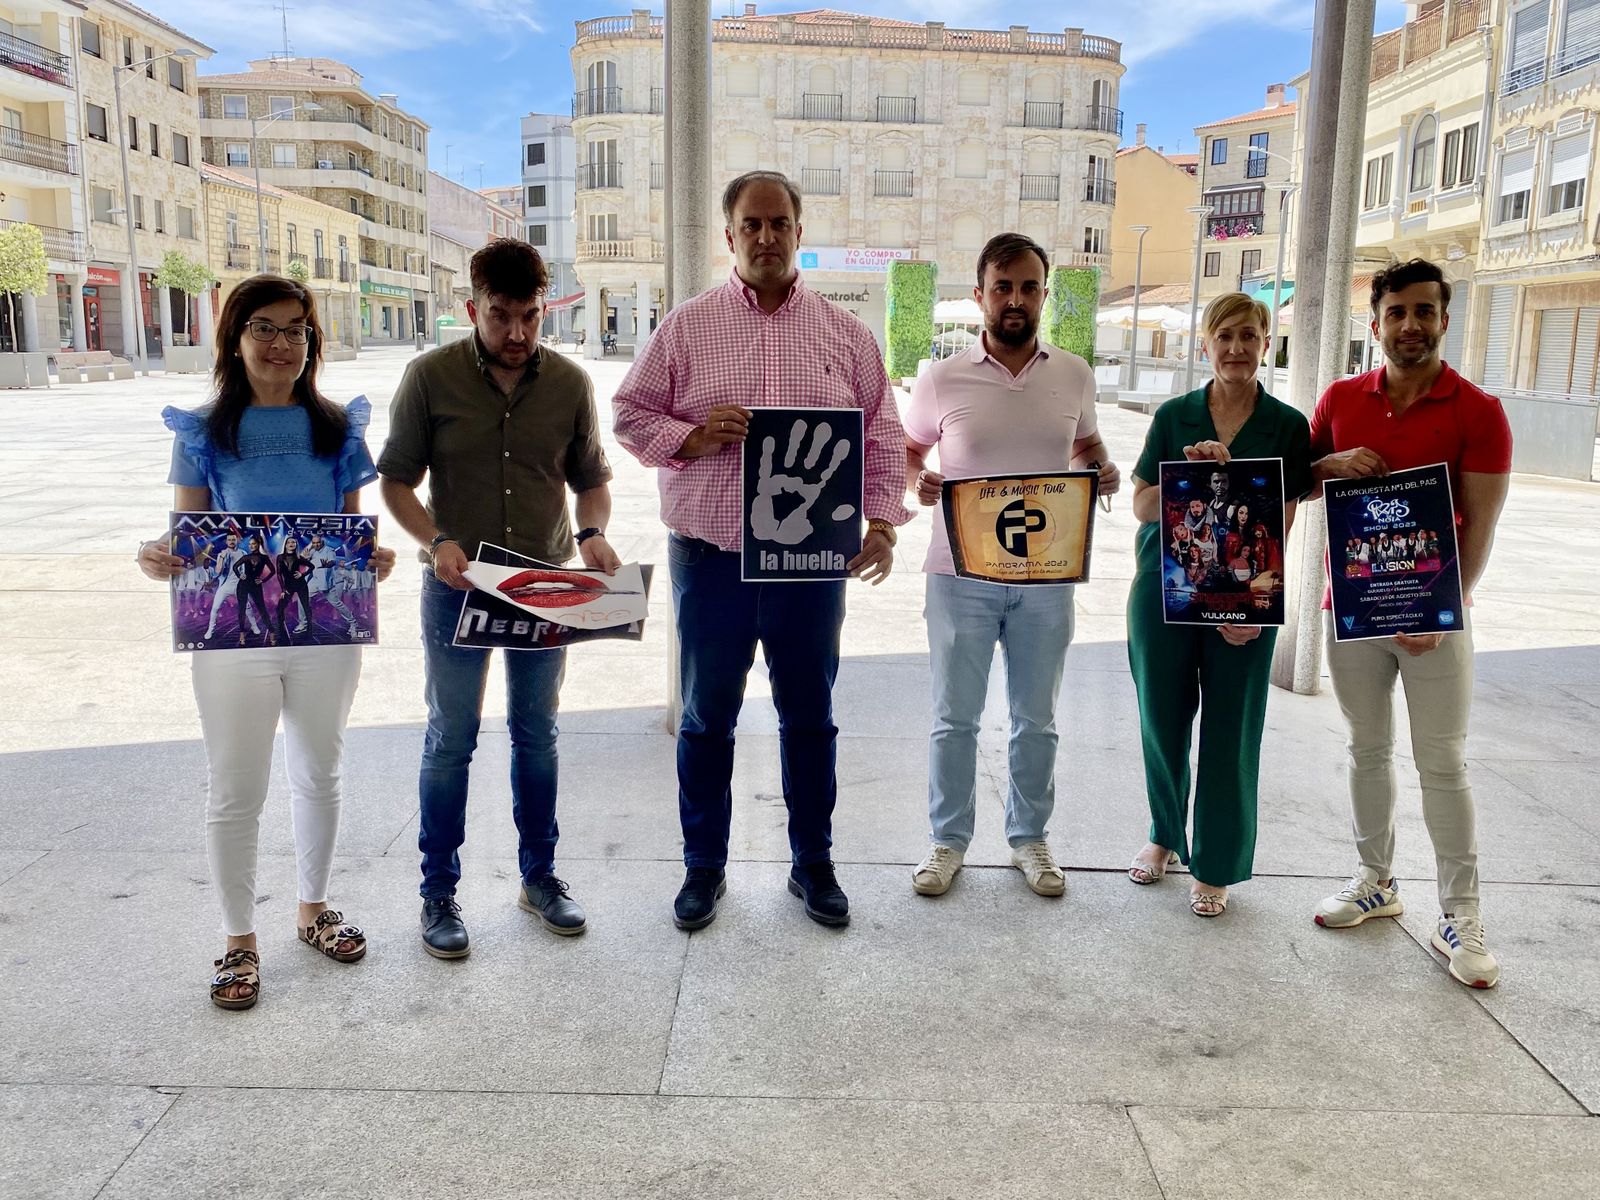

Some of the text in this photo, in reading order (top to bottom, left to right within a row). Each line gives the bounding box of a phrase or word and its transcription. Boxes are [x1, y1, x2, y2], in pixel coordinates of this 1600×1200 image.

[864, 250, 902, 258] COMPRO
[979, 486, 996, 500] LIFE
[1011, 484, 1040, 496] MUSIC
[1043, 482, 1066, 495] TOUR
[1335, 490, 1347, 498] LA
[1347, 486, 1390, 497] ORQUESTA
[1404, 481, 1420, 490] DEL
[174, 514, 376, 530] MALASSIA
[1363, 521, 1417, 532] SHOW 2023
[760, 550, 845, 571] la huella
[986, 561, 1041, 569] PANORAMA
[1201, 612, 1246, 620] VULKANO
